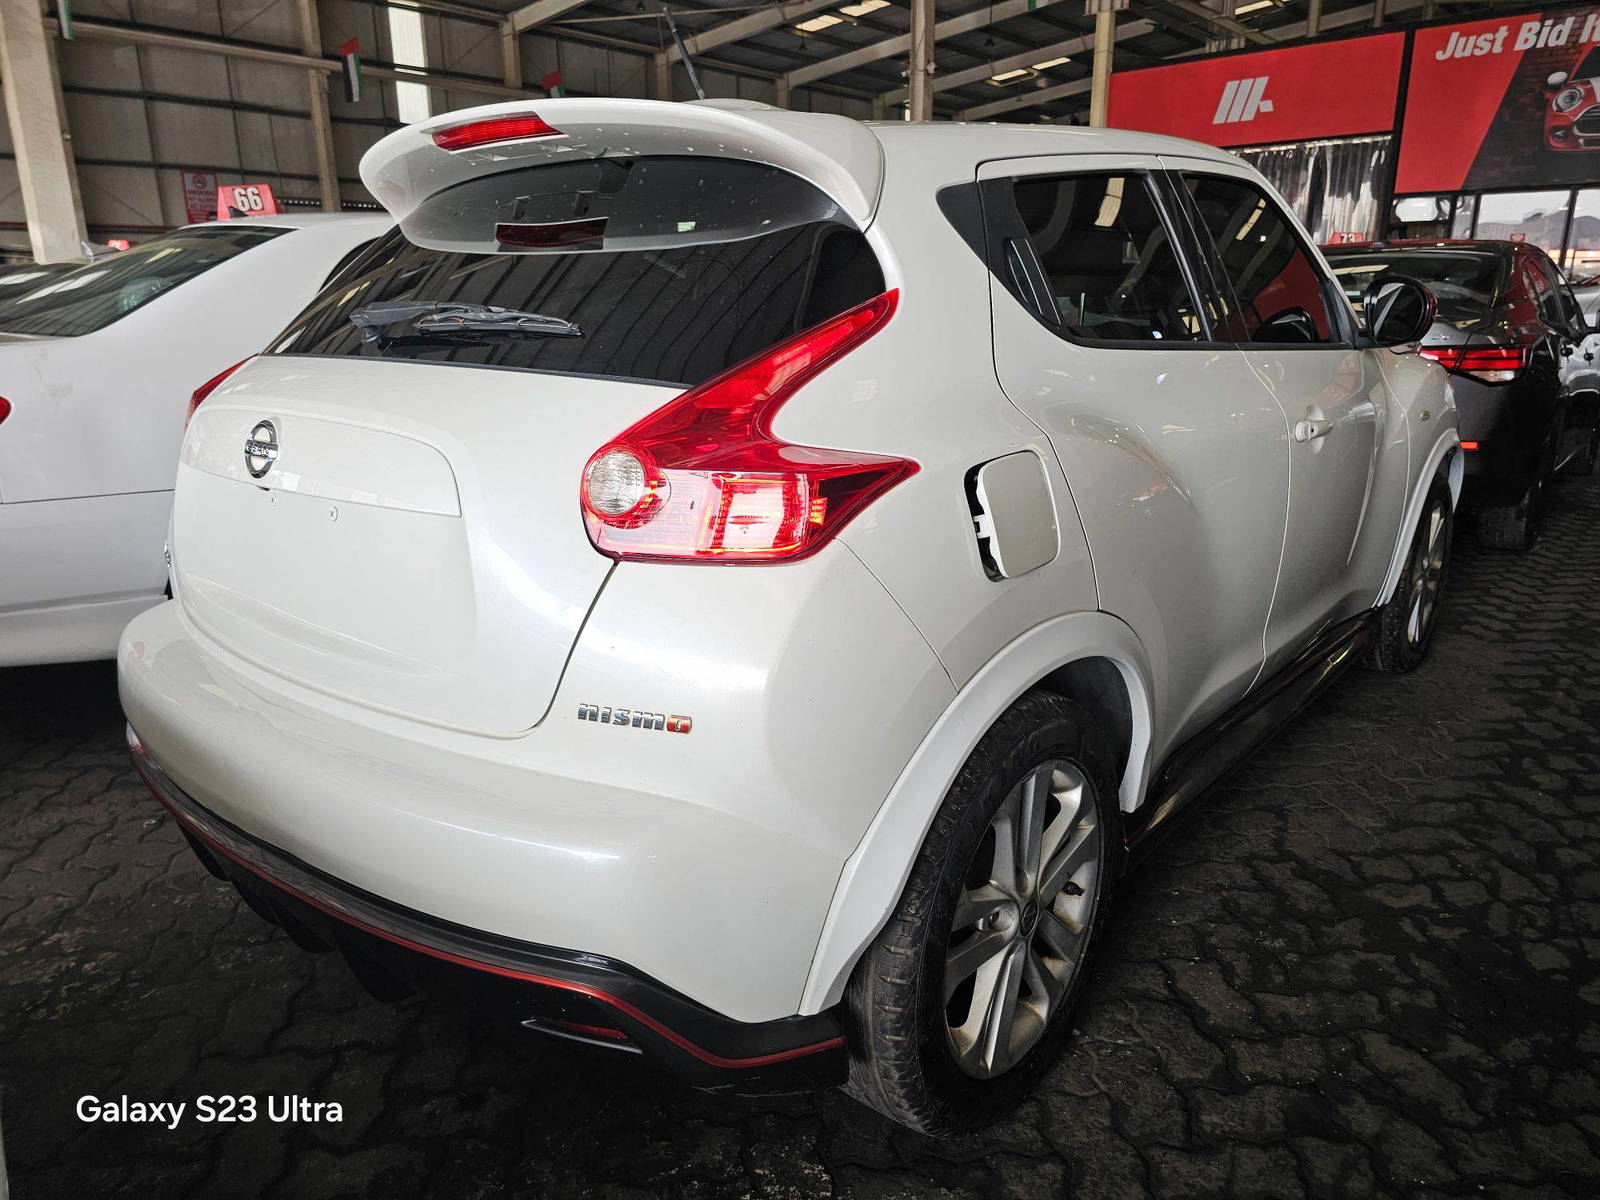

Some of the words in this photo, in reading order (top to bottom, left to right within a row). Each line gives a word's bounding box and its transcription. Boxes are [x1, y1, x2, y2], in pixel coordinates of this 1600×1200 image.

[1435, 26, 1508, 60] Just
[1514, 17, 1575, 50] Bid
[234, 187, 262, 212] 66
[578, 703, 692, 734] nismo
